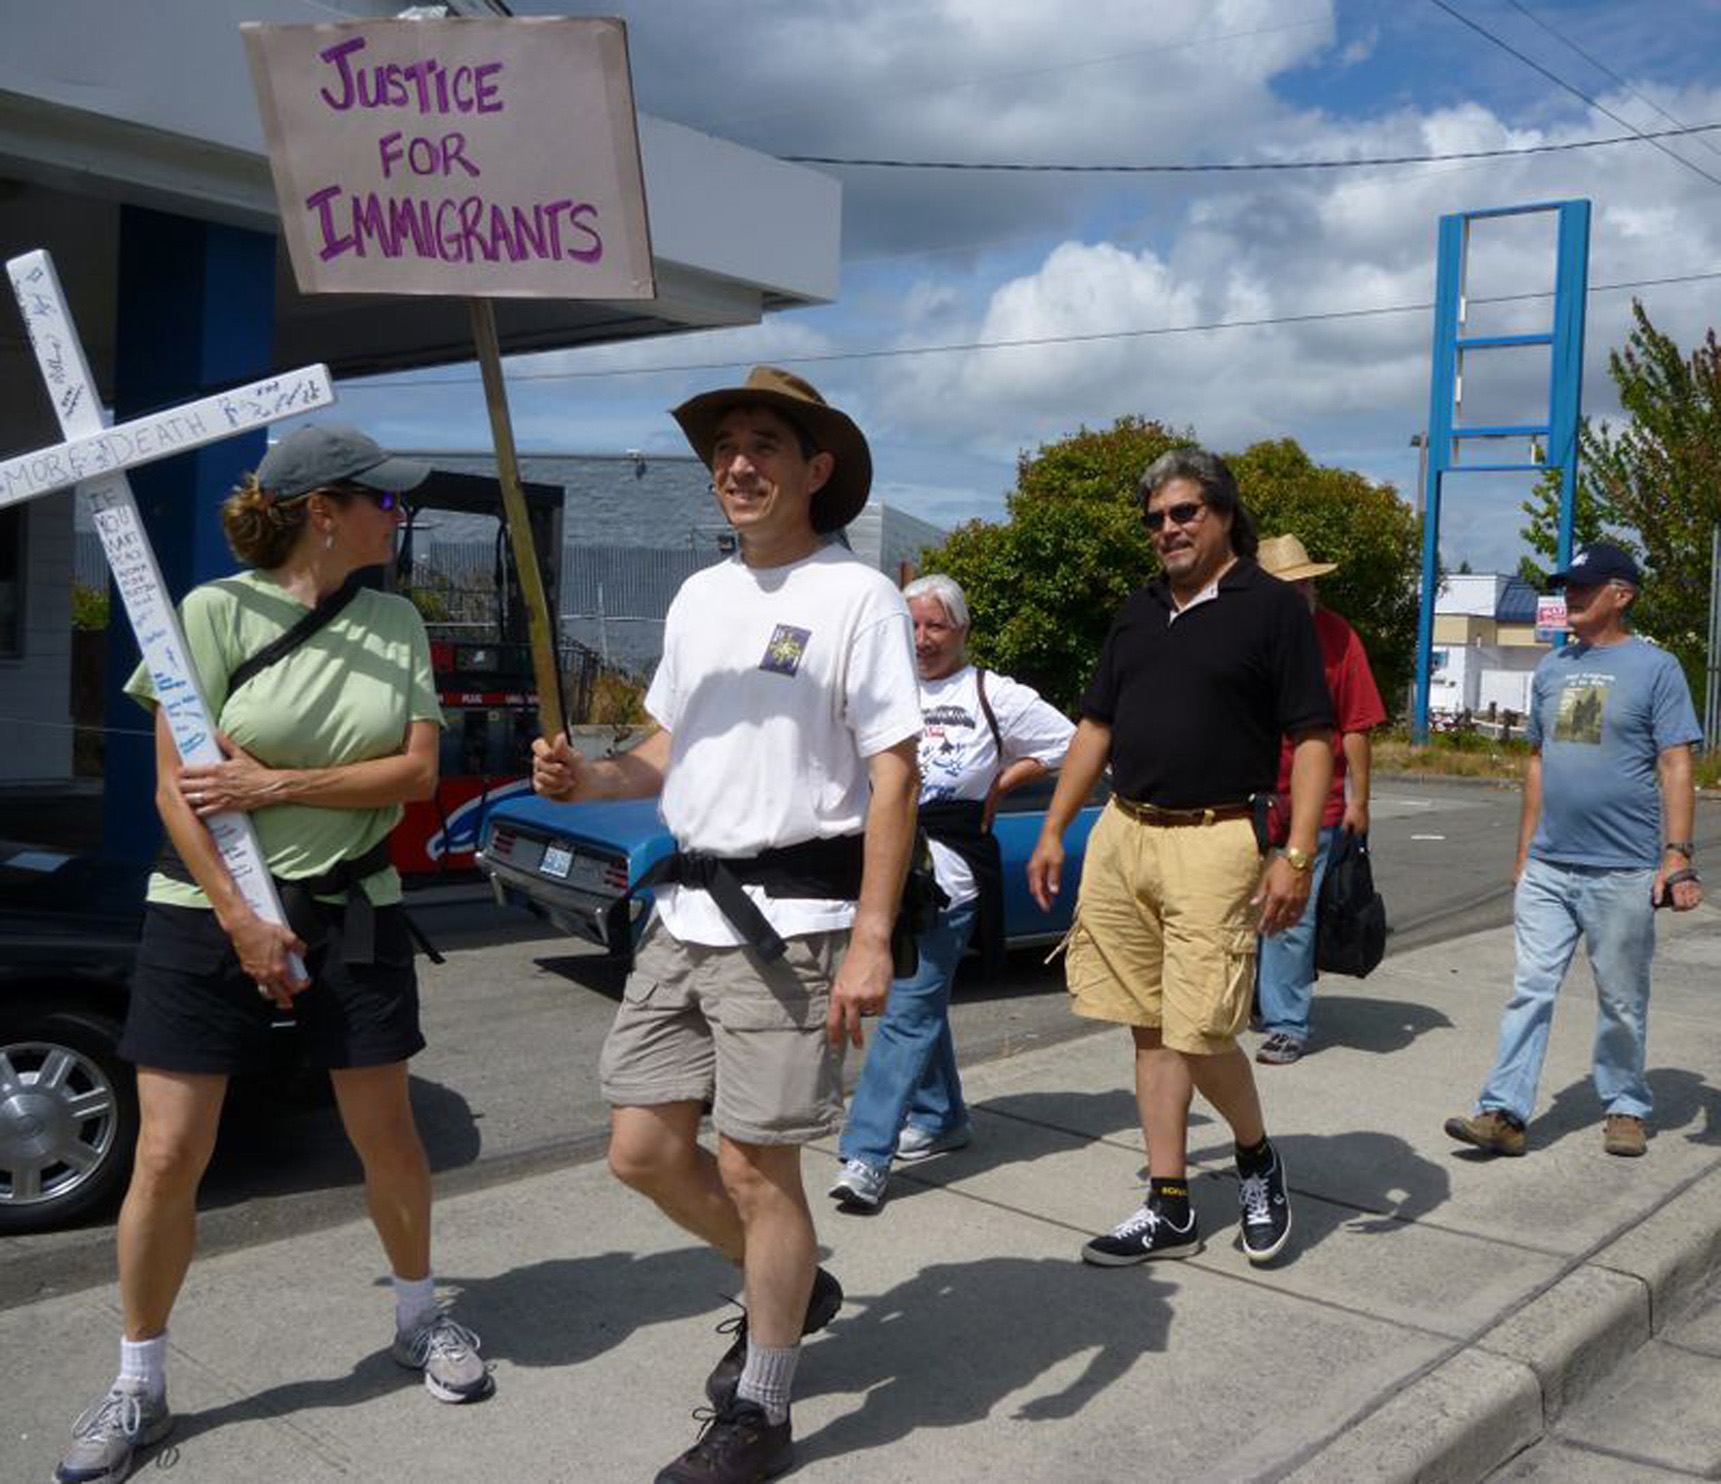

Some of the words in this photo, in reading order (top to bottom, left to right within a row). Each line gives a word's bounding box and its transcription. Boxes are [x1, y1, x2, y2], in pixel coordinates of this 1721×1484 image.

[321, 37, 503, 115] JUSTICE
[379, 132, 481, 177] FOR
[306, 186, 603, 264] IMMIGRANTS
[4, 446, 86, 497] MORE
